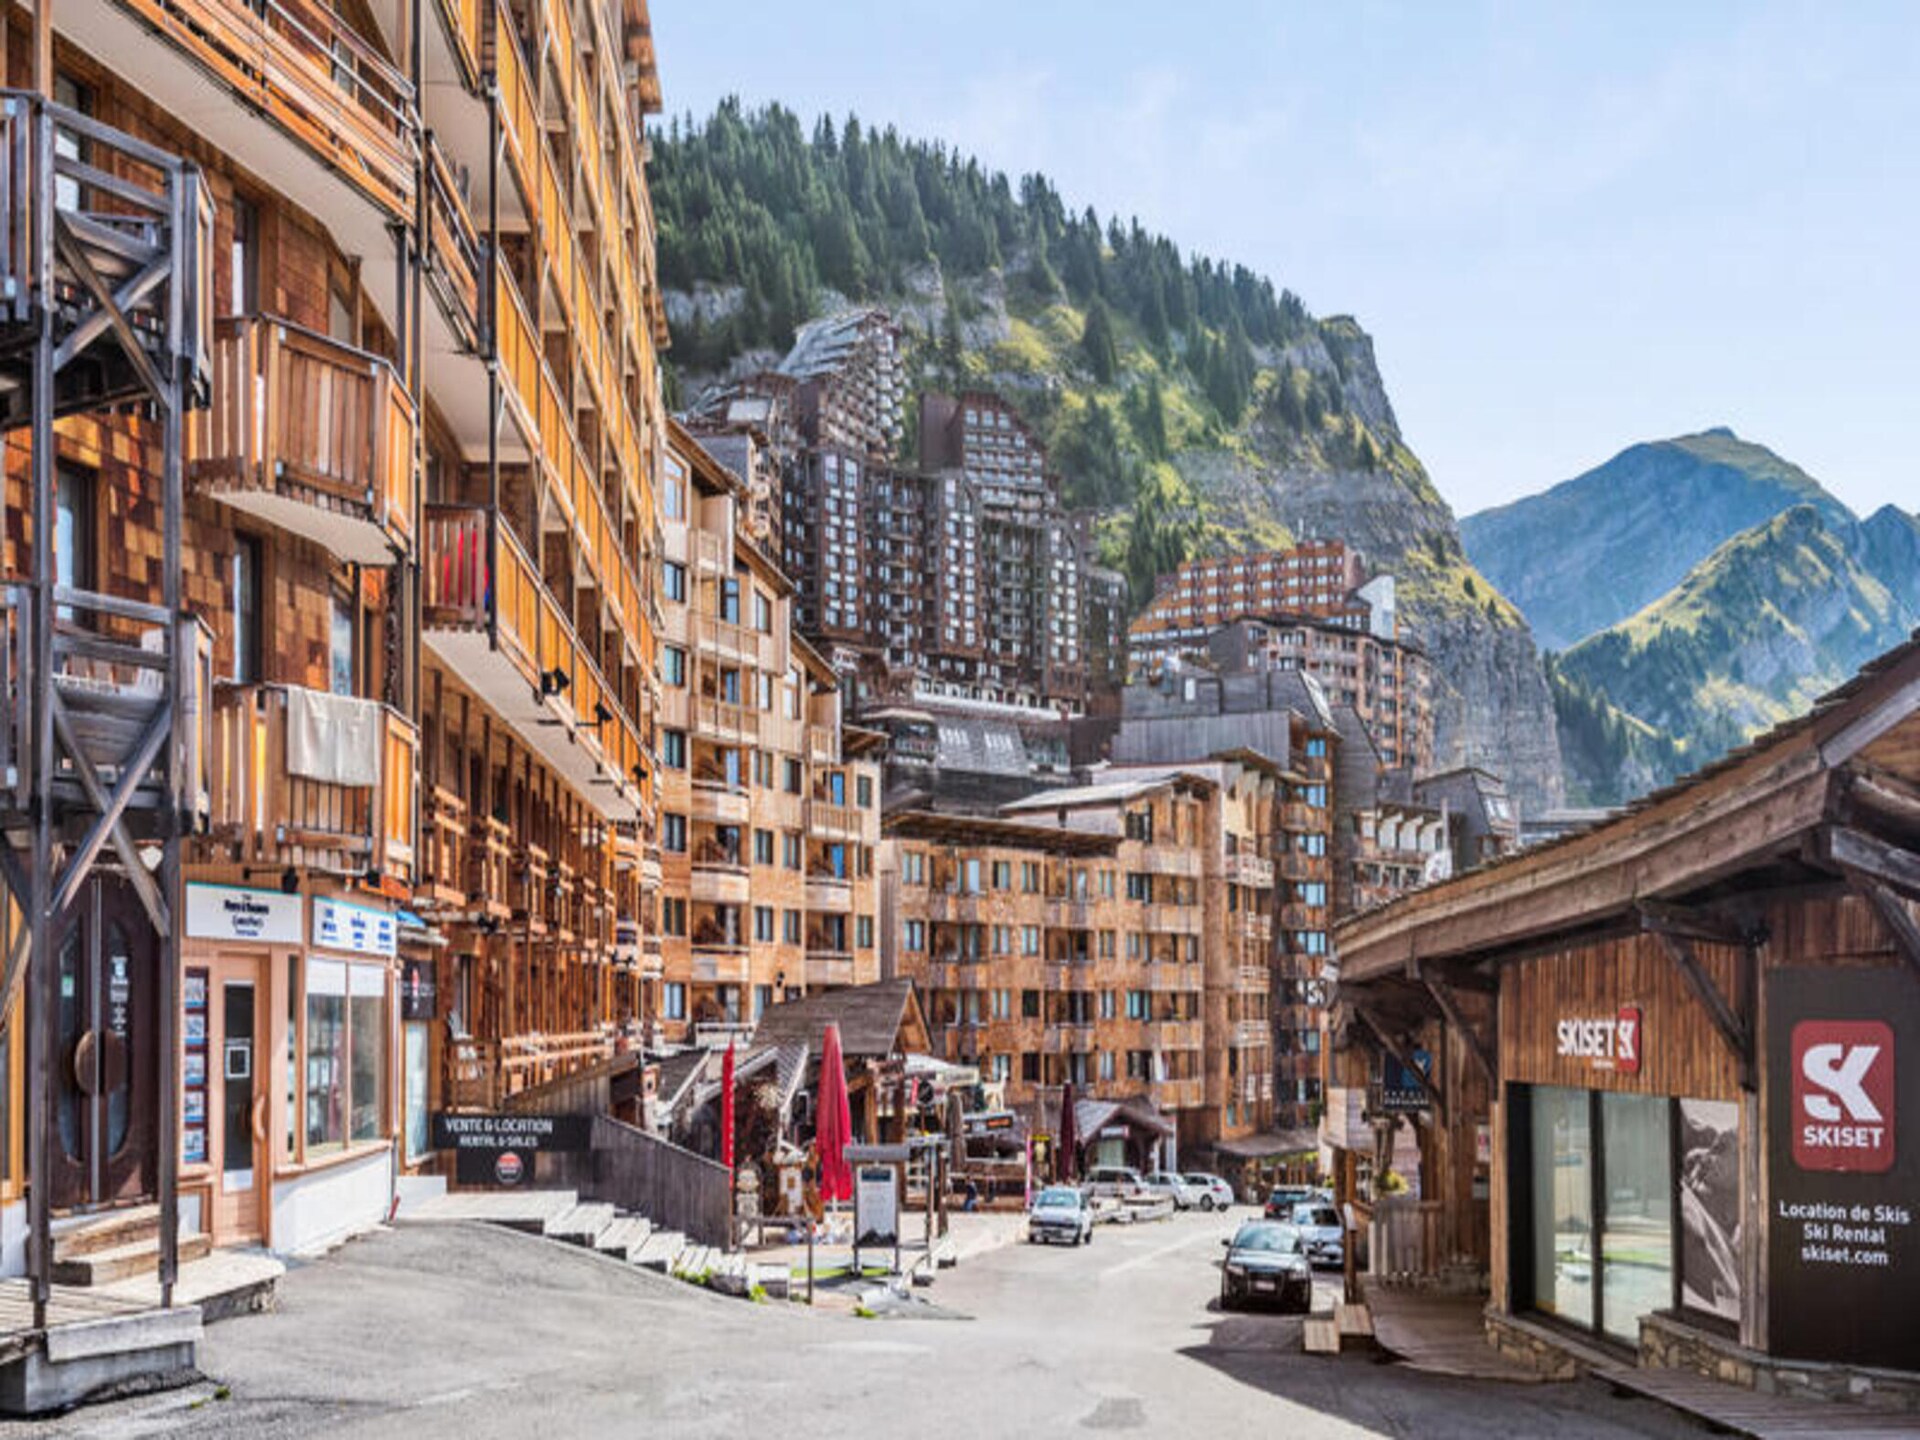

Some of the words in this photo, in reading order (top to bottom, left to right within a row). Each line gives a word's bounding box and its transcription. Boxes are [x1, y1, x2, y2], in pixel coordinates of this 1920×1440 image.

[1557, 1019, 1616, 1057] SKISET
[446, 1118, 482, 1133] VENTE
[494, 1118, 553, 1134] LOCATION
[1803, 1125, 1885, 1148] SKISET
[459, 1136, 496, 1148] RENTAL
[505, 1136, 539, 1148] SALES
[1779, 1200, 1847, 1221] Location
[1850, 1204, 1870, 1222] de
[1874, 1204, 1910, 1225] Skis
[1803, 1223, 1828, 1240] Ski
[1832, 1224, 1886, 1244] Rental
[1801, 1245, 1889, 1266] skiset.com
